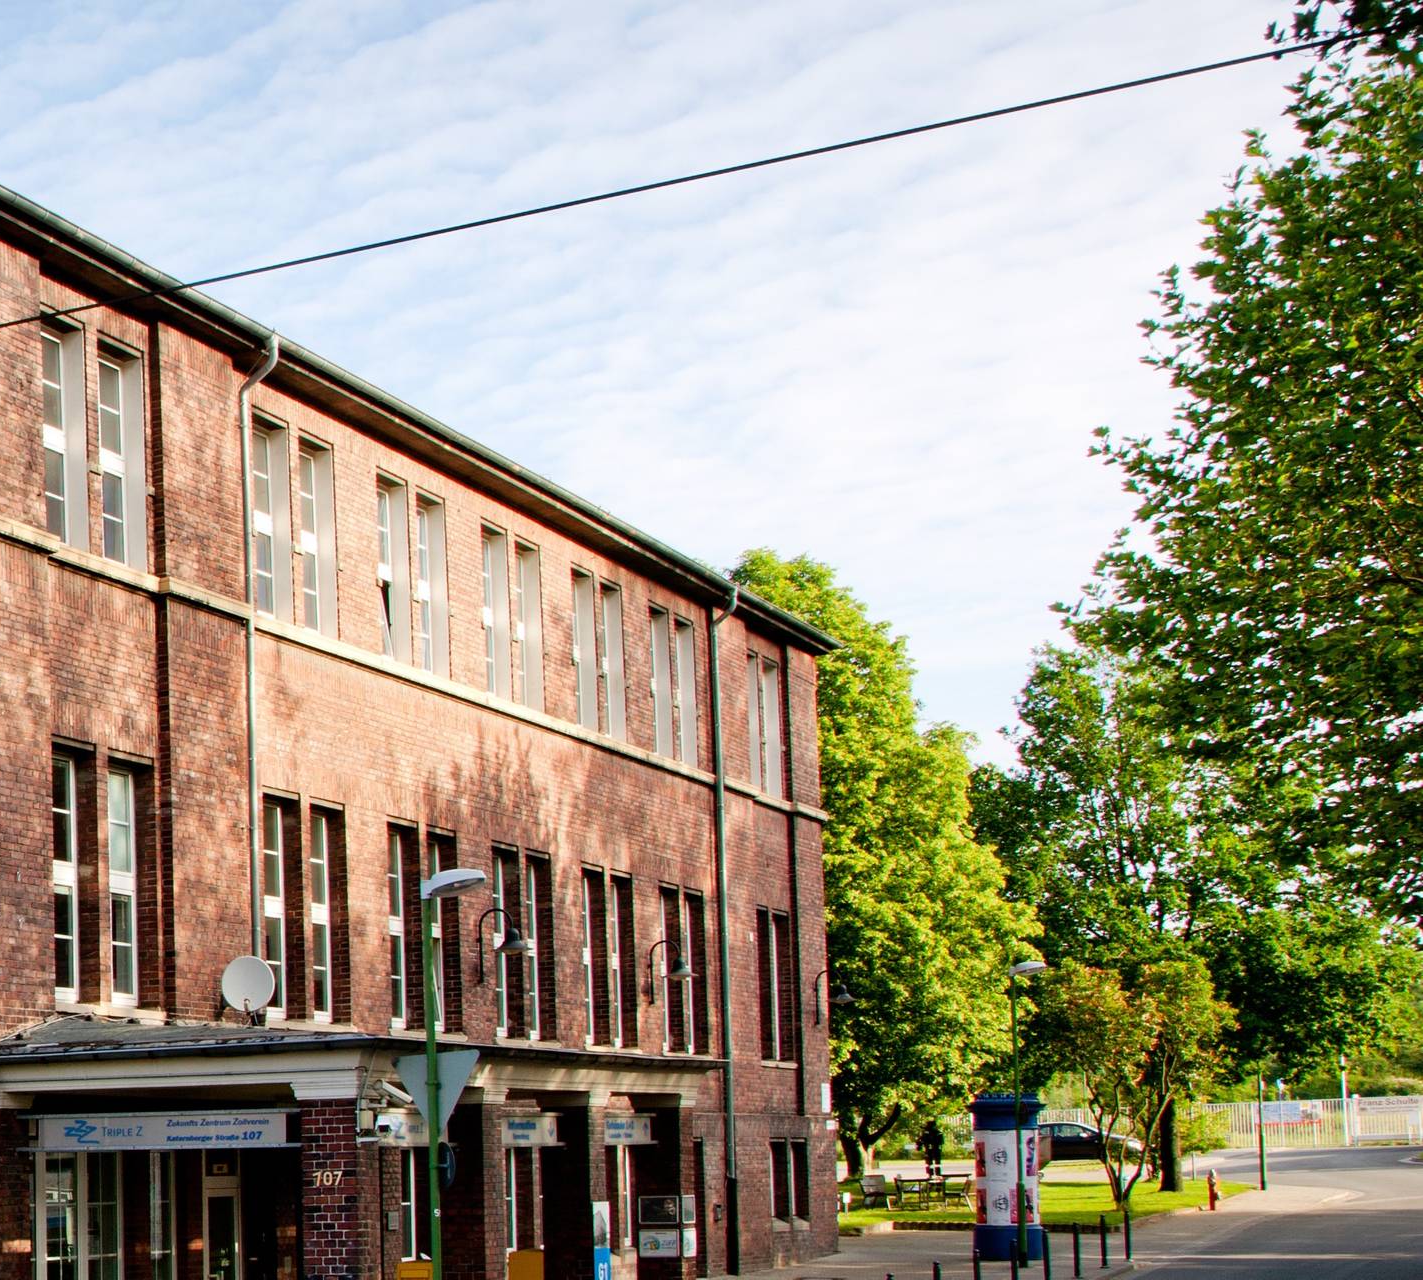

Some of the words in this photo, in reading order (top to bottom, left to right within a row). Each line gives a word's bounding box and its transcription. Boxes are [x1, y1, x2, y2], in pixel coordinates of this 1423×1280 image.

[166, 1119, 198, 1128] Zukunfts
[200, 1118, 231, 1127] Zentrum
[232, 1117, 270, 1126] Zollverein
[166, 1134, 214, 1143] Katernberger
[241, 1130, 263, 1141] 107
[313, 1170, 343, 1187] 107
